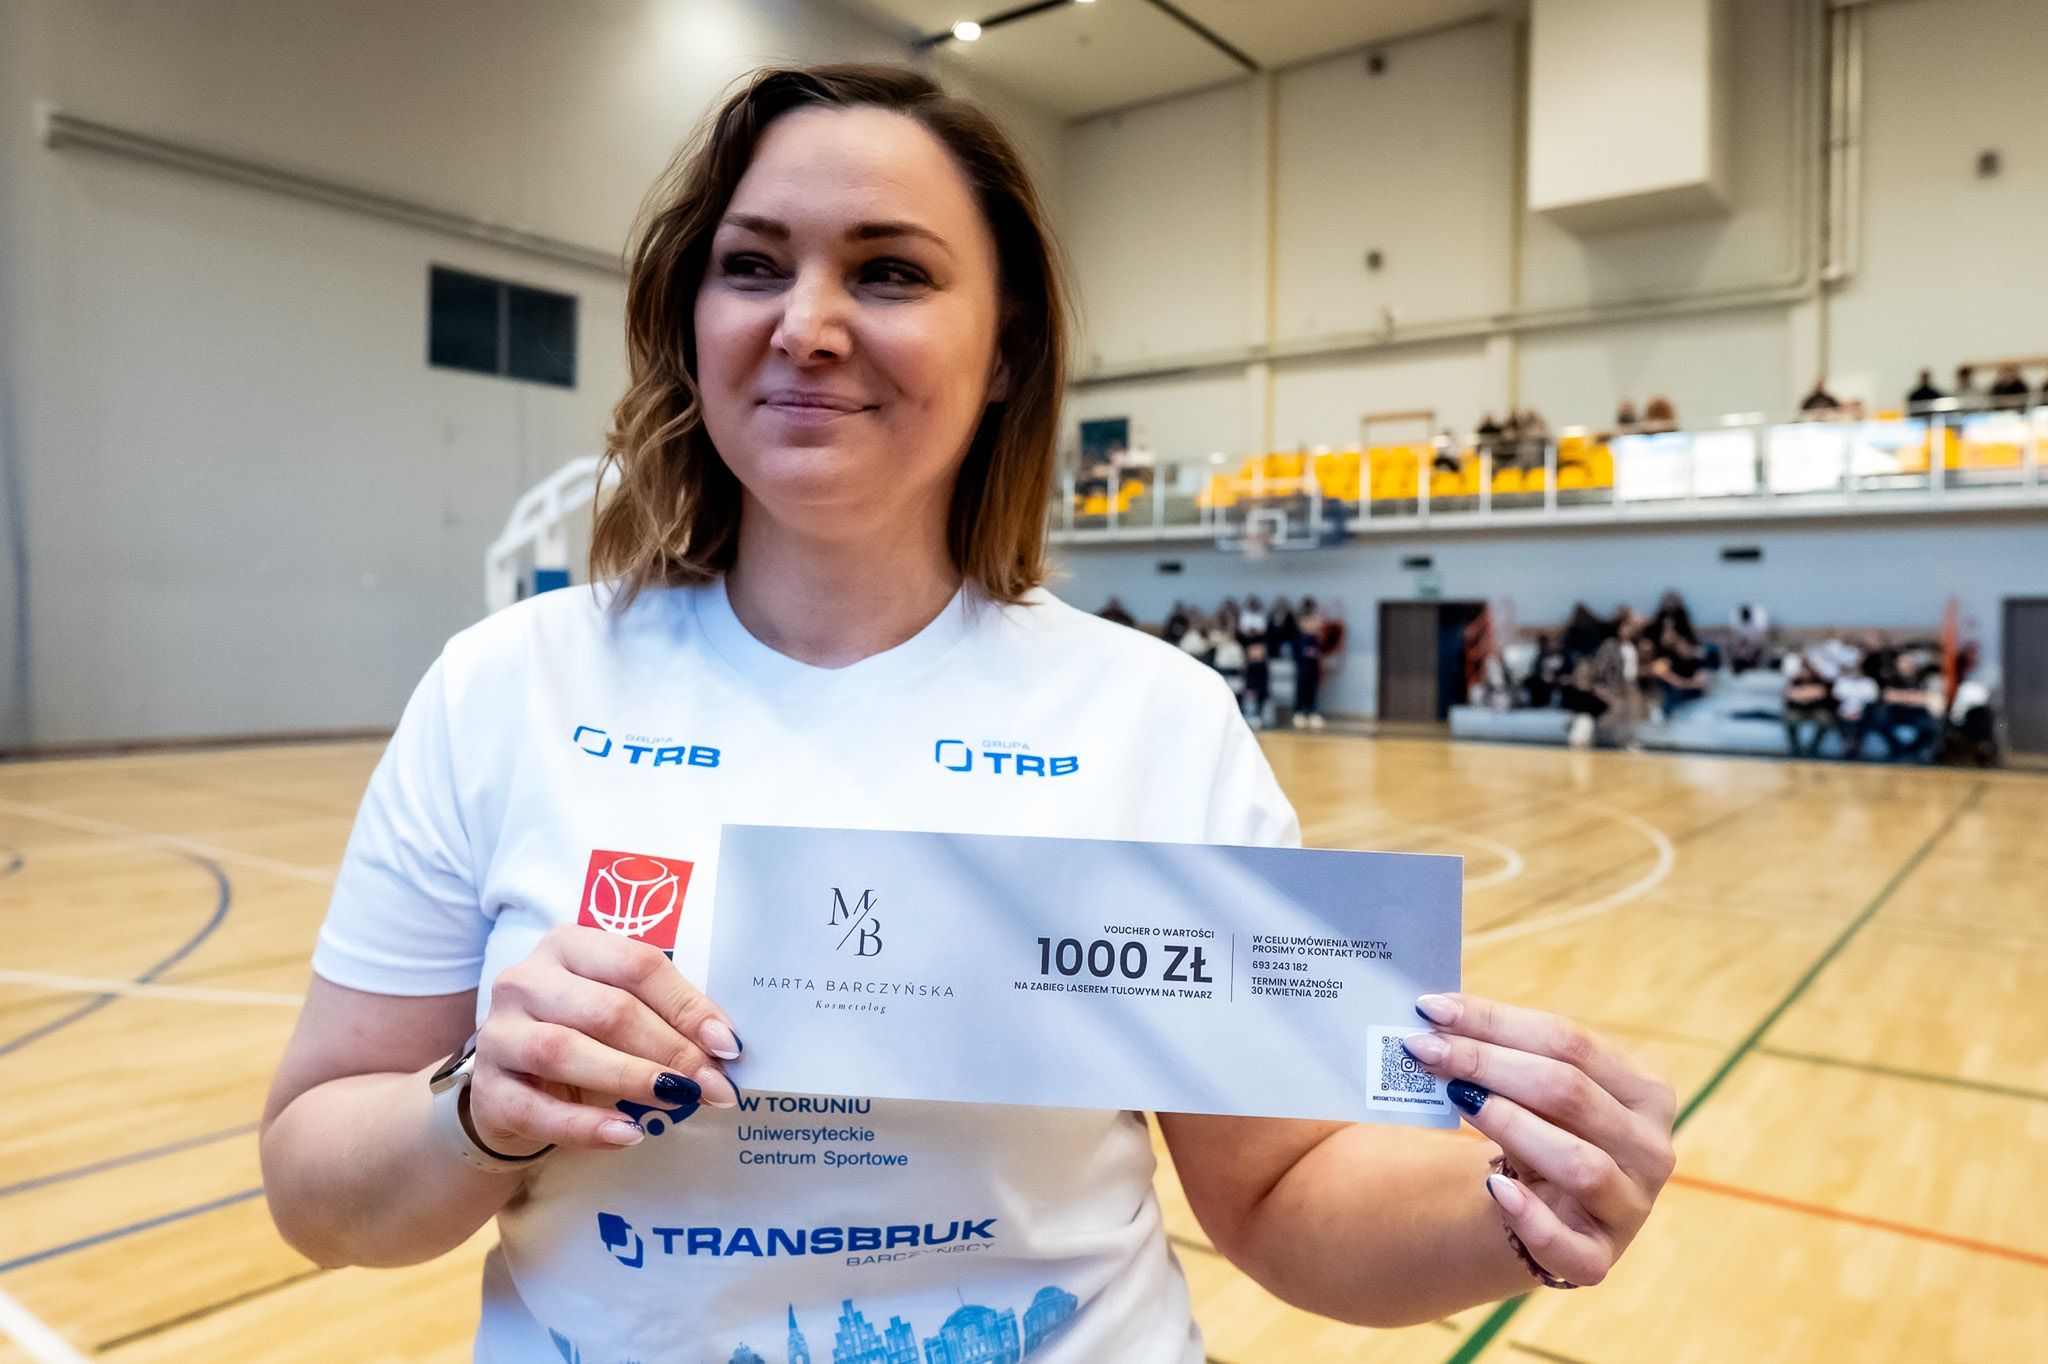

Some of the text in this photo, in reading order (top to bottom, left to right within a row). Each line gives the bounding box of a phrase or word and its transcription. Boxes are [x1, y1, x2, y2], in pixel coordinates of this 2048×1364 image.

[982, 739, 1030, 750] GRUPA
[622, 744, 721, 768] TRB
[983, 752, 1079, 777] TRB
[1104, 925, 1215, 939] VOUCHER O WARTOŚCI
[1253, 935, 1388, 950] W CELU UMÓWIENIA WIZYTY
[1037, 937, 1213, 983] 1000 ZŁ
[1252, 945, 1393, 960] PROSIMY O KONTAKT POD NR
[1252, 961, 1308, 971] 693 243 182
[752, 976, 954, 997] MARTA BARCZYŃSKA
[1014, 981, 1213, 999] NA ZABIEG LASEREM TULOWYM NA TWARZ
[1251, 977, 1343, 989] TERMIN WAŻNOŚCI
[1251, 986, 1338, 999] 30 KWIETNIA 2026
[815, 1000, 886, 1014] Kosmetolog
[738, 1097, 871, 1114] W TORUNIU
[738, 1126, 875, 1144] Uniwersyteckie
[739, 1150, 908, 1168] Centrum Sportowe
[652, 1218, 999, 1257] TRANSBRUK
